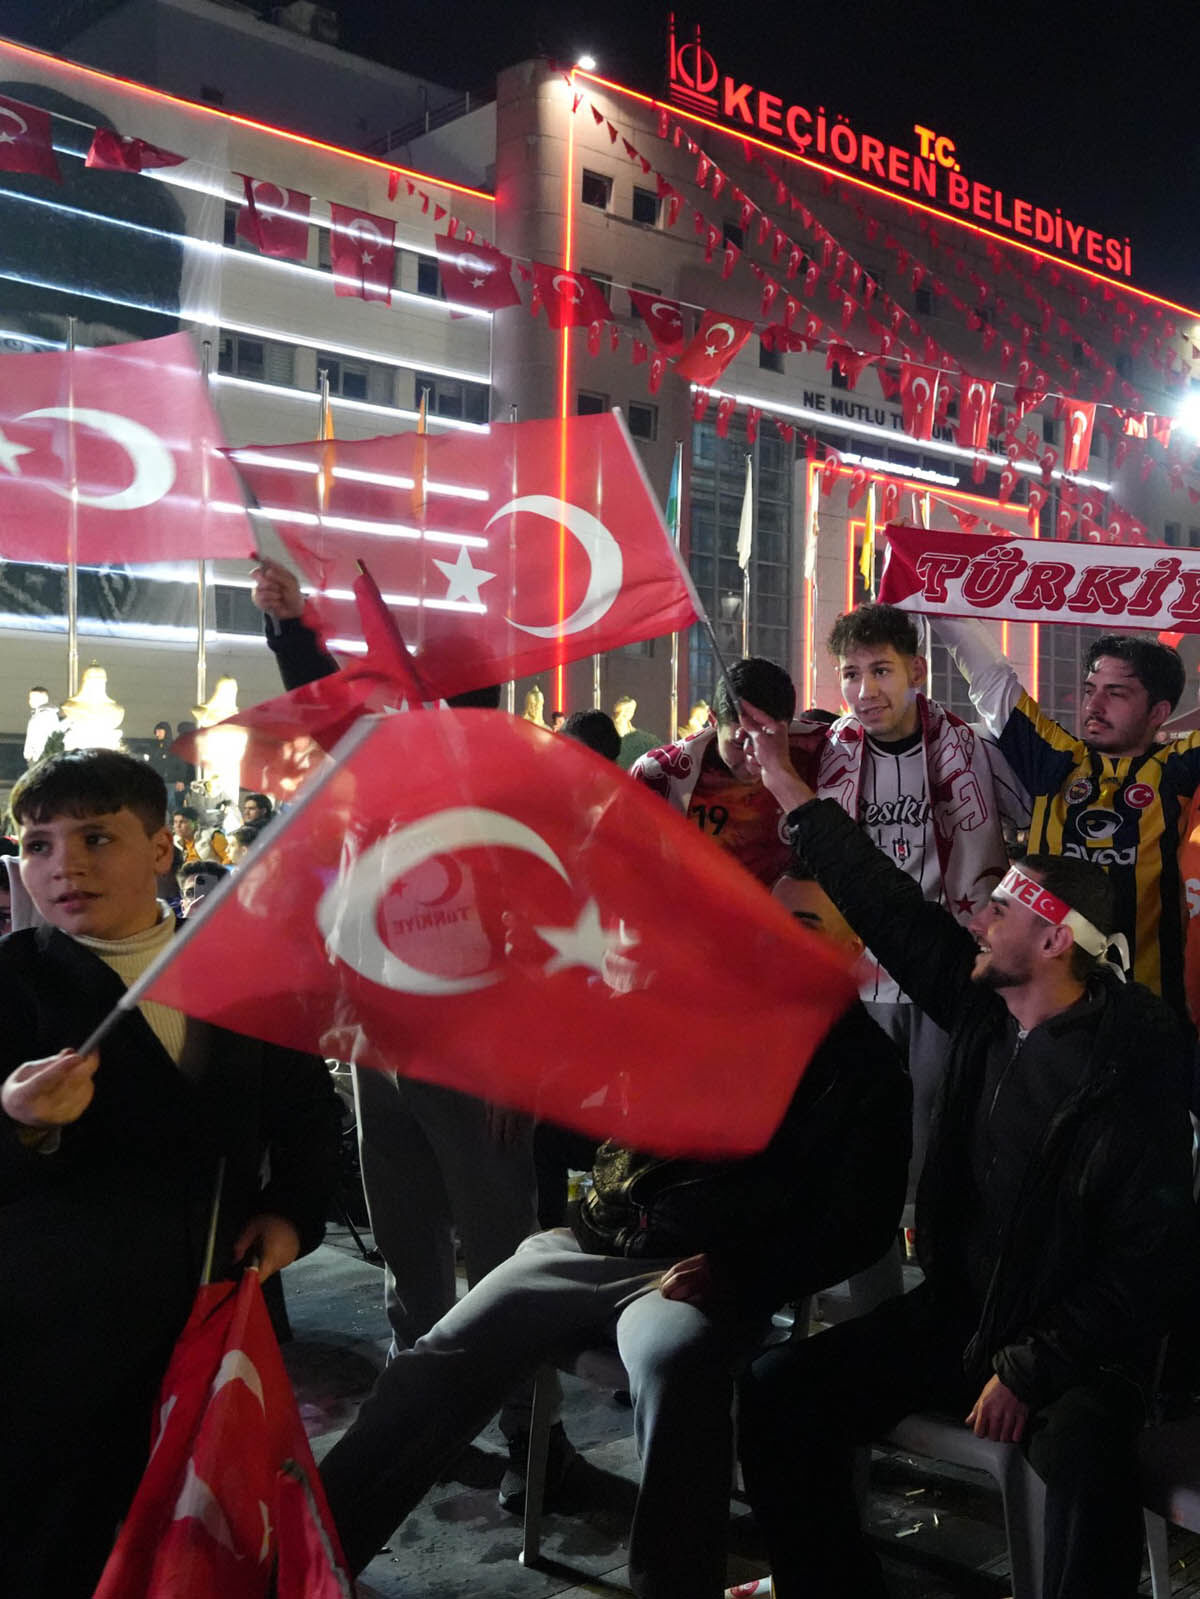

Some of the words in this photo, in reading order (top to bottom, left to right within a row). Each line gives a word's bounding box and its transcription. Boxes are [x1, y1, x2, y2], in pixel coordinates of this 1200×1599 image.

[914, 124, 961, 172] T.C.
[724, 75, 937, 198] KEÇİÖREN
[948, 167, 1133, 276] BELEDİYESİ
[803, 391, 825, 411] NE
[831, 397, 885, 426] MUTLU
[692, 804, 729, 836] 19
